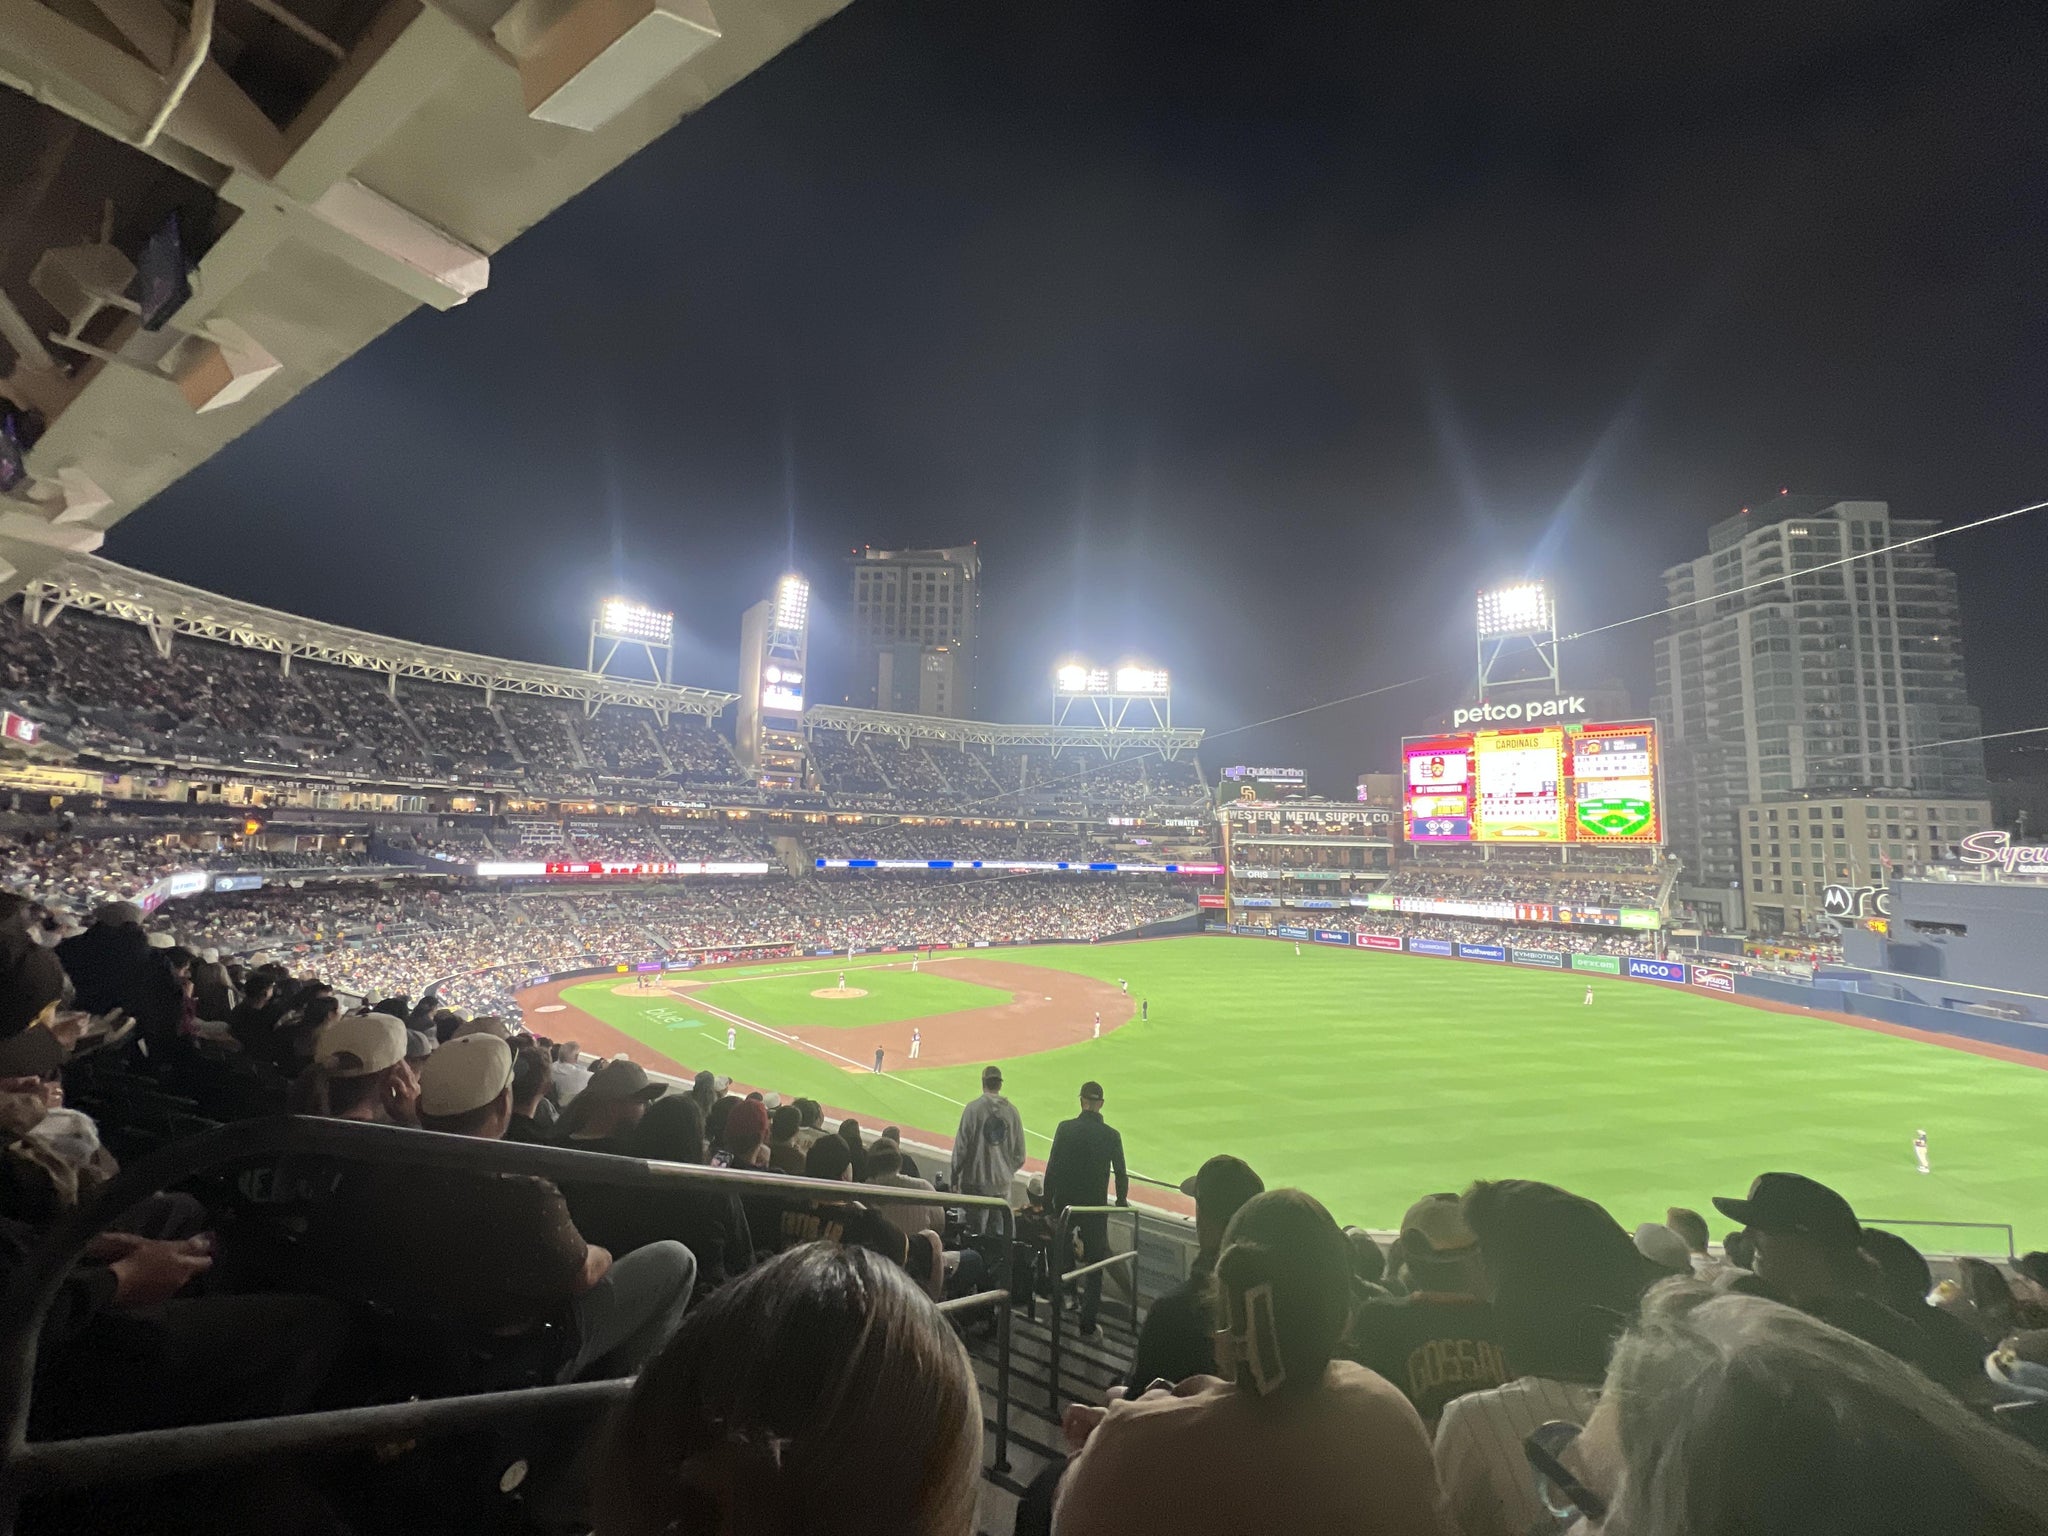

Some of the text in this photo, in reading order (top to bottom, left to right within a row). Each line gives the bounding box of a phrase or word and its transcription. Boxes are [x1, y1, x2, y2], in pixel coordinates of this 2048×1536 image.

[1454, 696, 1585, 728] petco park
[1495, 738, 1540, 749] CARDINALS
[305, 782, 350, 792] CENTER
[1229, 810, 1281, 821] WESTERN
[1285, 812, 1322, 822] METAL
[1325, 813, 1368, 823] SUPPLY
[1165, 819, 1199, 827] CUTWATER
[1247, 871, 1268, 879] ORIS
[1462, 947, 1496, 956] Southwest
[1631, 963, 1669, 976] ARCO
